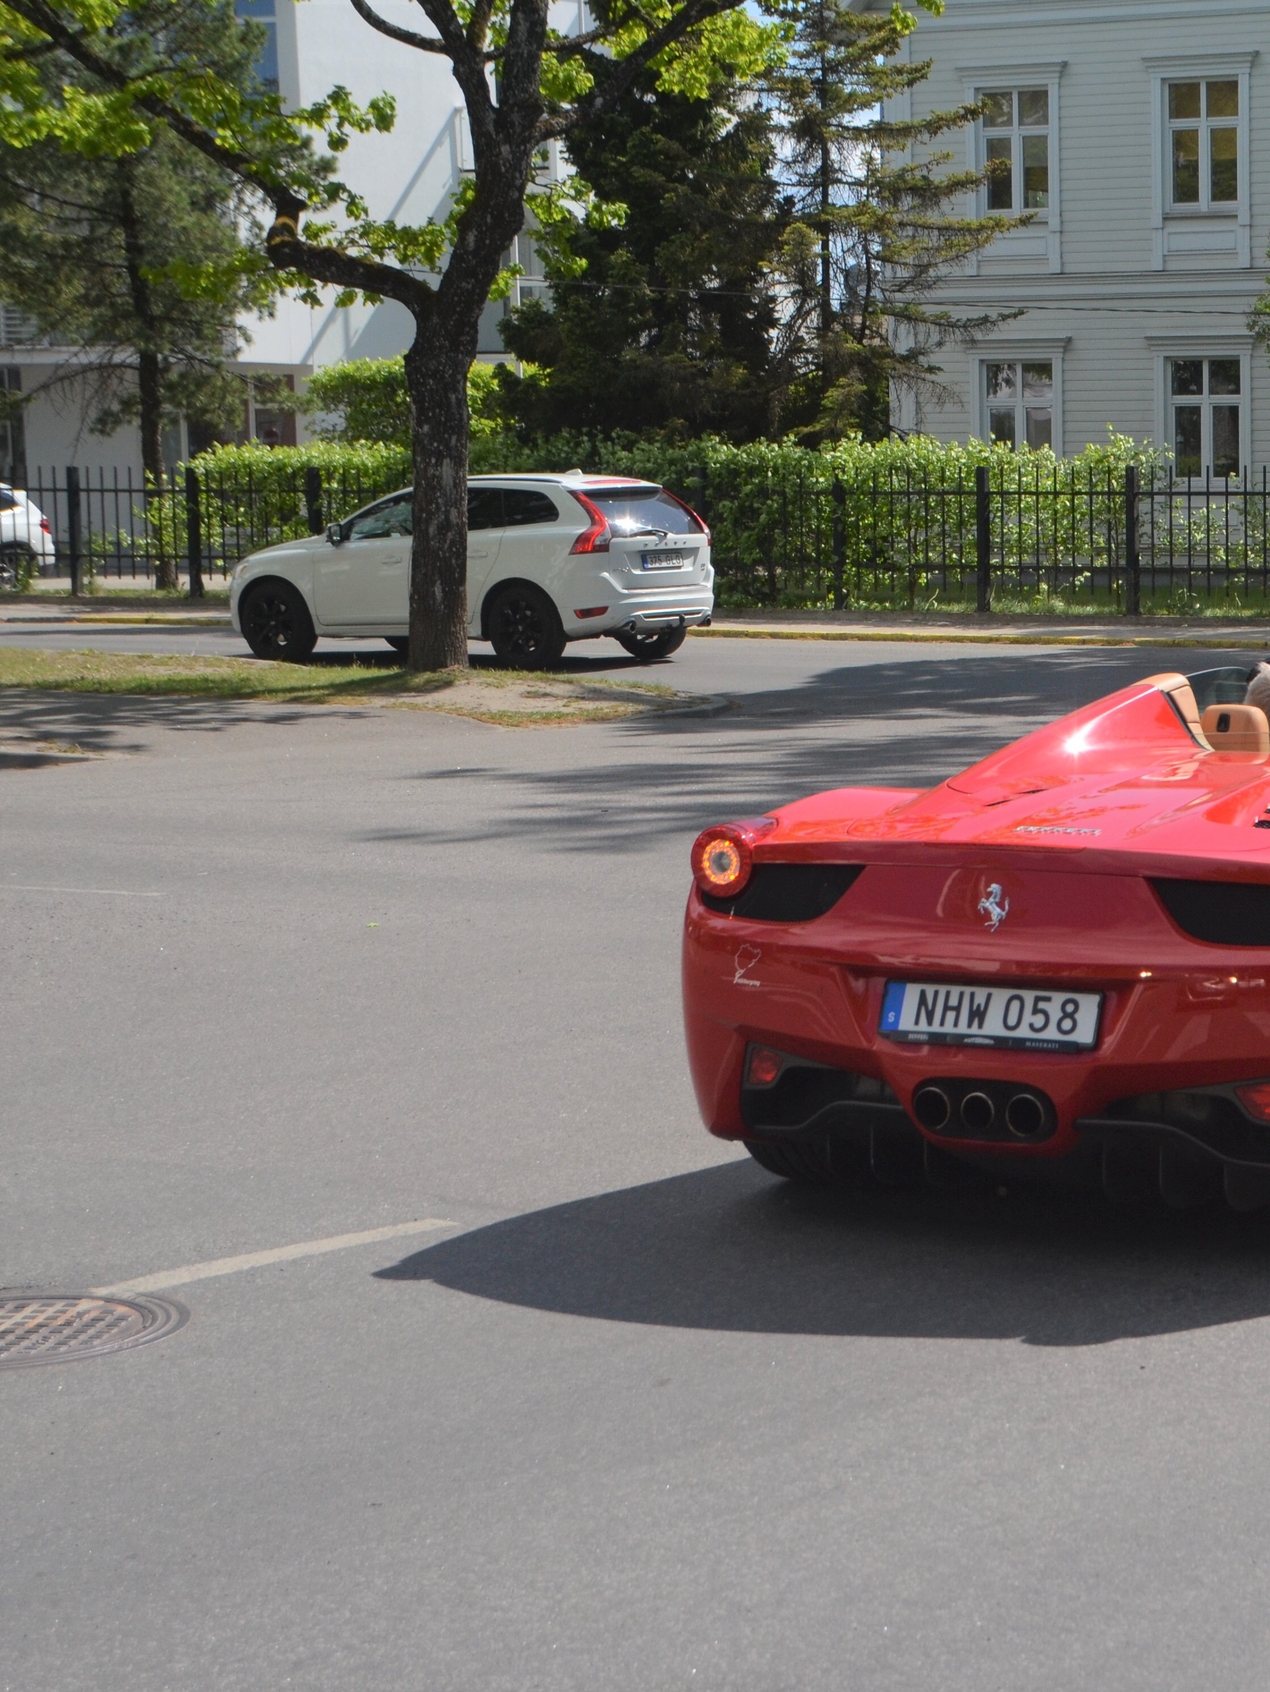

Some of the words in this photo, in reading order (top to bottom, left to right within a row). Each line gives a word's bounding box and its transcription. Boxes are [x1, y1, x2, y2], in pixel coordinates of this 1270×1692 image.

[648, 555, 663, 567] 375
[887, 1011, 896, 1023] S
[913, 988, 993, 1030] NHW
[1002, 994, 1080, 1036] 058
[1025, 1040, 1059, 1050] MASERATI
